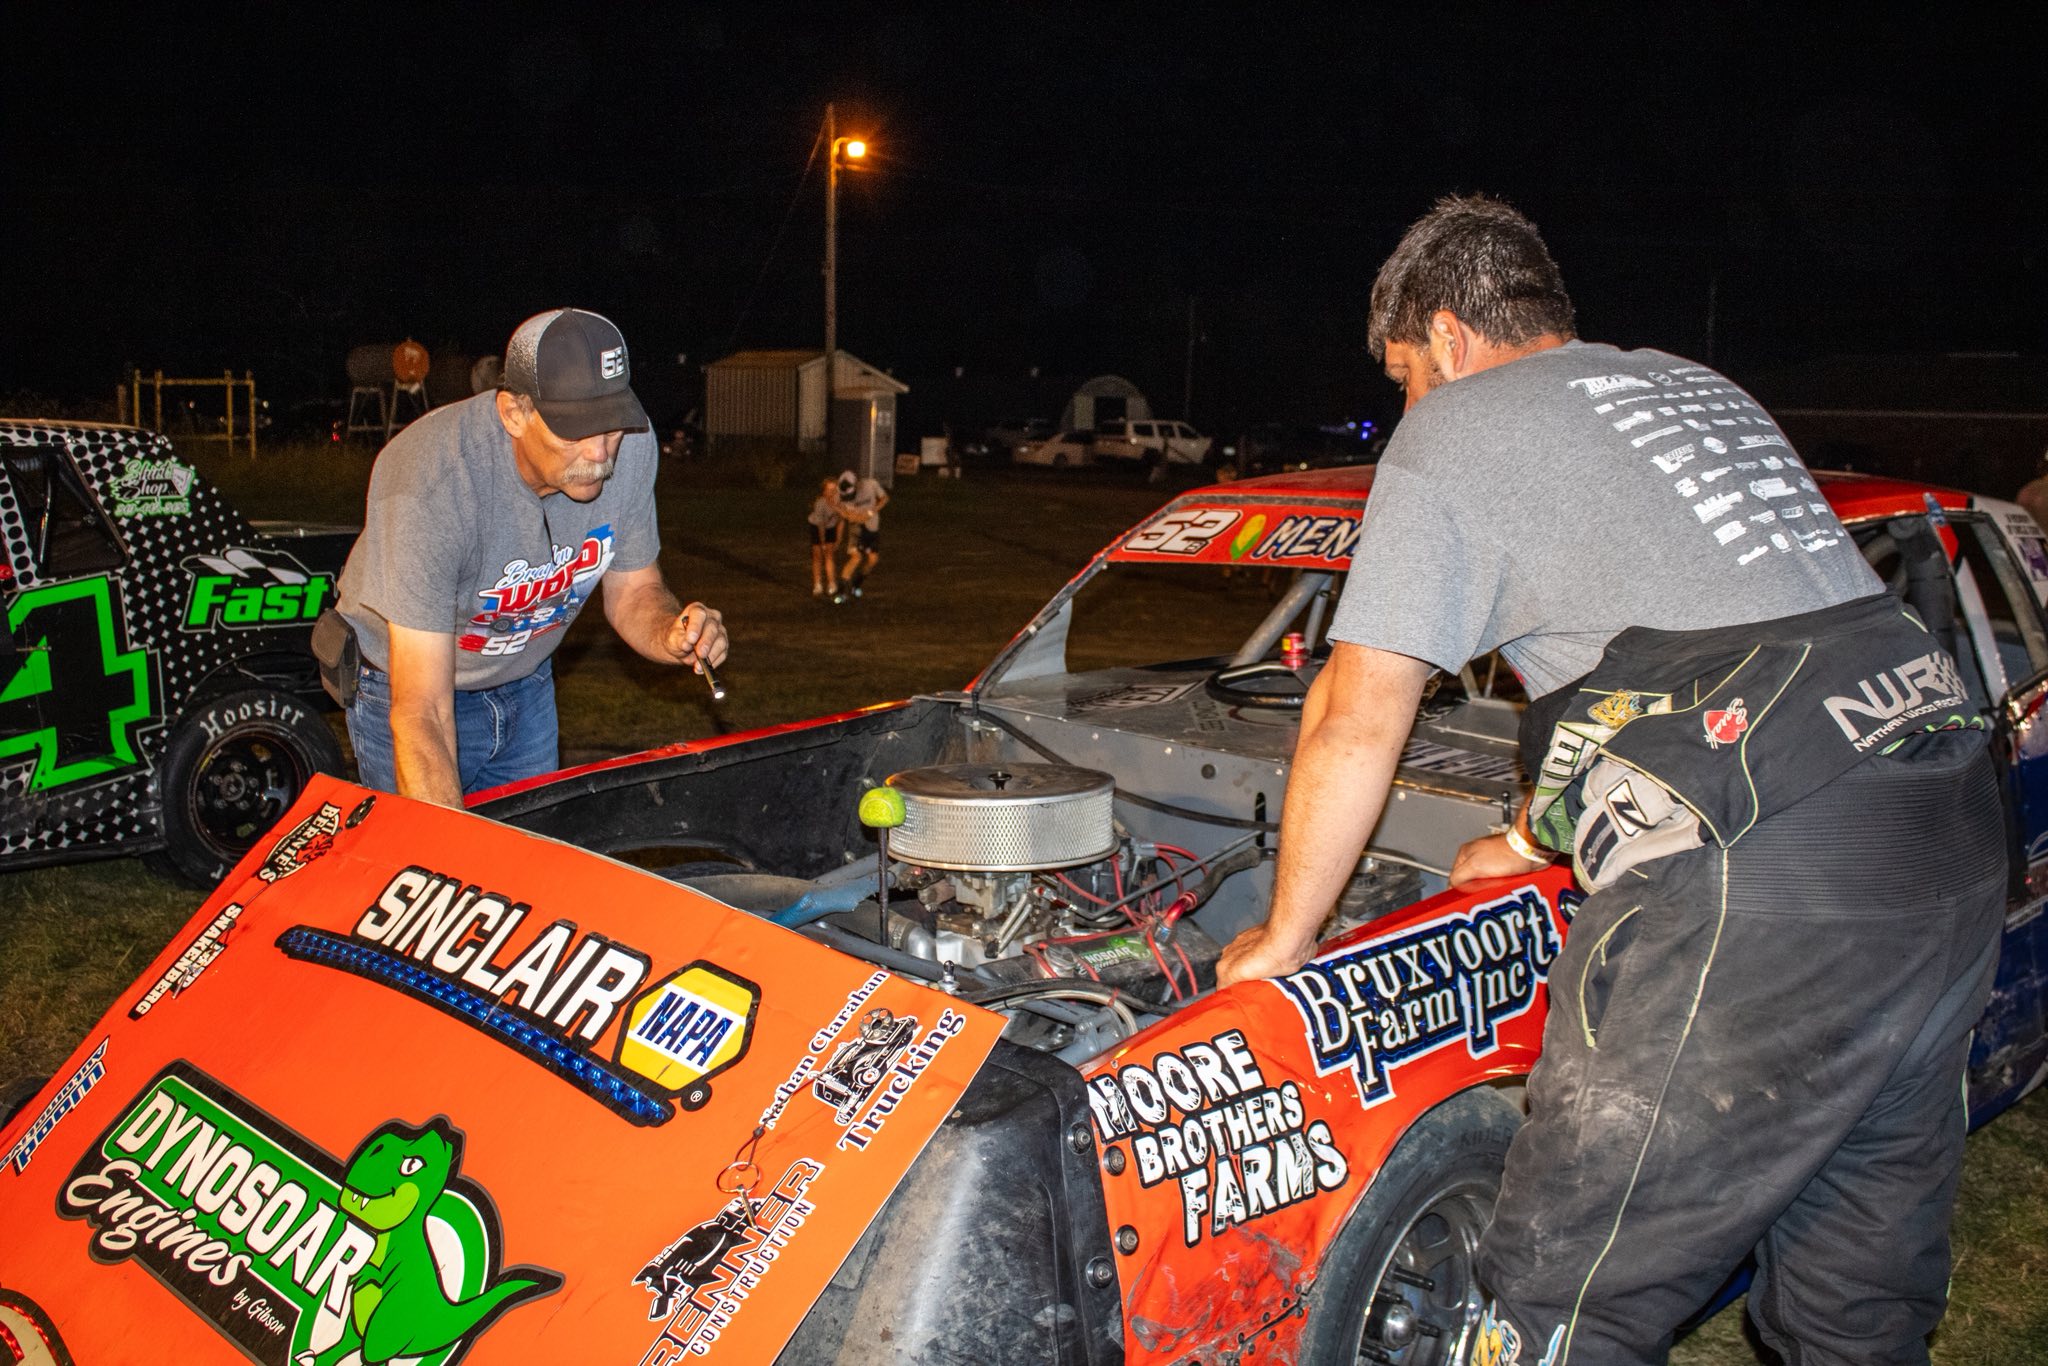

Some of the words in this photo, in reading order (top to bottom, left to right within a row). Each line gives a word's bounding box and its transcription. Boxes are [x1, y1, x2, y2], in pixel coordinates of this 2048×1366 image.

[602, 346, 625, 379] 52
[120, 474, 169, 503] Shop
[1125, 510, 1240, 555] 52
[188, 573, 329, 627] Fast
[481, 629, 533, 656] 52
[0, 575, 151, 796] 4
[1853, 716, 1908, 752] NATHAN
[259, 803, 341, 883] BERNIE'S
[135, 903, 243, 1015] SNAKENBERG
[357, 871, 645, 1041] SINCLAIR
[1083, 946, 1132, 966] NOSOAR
[1287, 893, 1555, 1054] Bruxvoort
[637, 990, 734, 1066] NAPA
[761, 1052, 813, 1128] Nathan
[809, 970, 890, 1052] Clarahan
[1352, 984, 1459, 1087] Farm
[1471, 961, 1527, 1038] Inc
[19, 1061, 106, 1171] Wood
[839, 1009, 964, 1150] Trucking
[1089, 1032, 1262, 1139] MOORE
[1136, 1085, 1303, 1185] BROTHERS
[1184, 1122, 1347, 1244] FARMS
[66, 1160, 252, 1287] Engines
[115, 1090, 376, 1317] DYNOSOAR
[233, 1288, 251, 1311] by
[248, 1299, 286, 1335] Gibson
[691, 1201, 814, 1357] CONSTRUCTION
